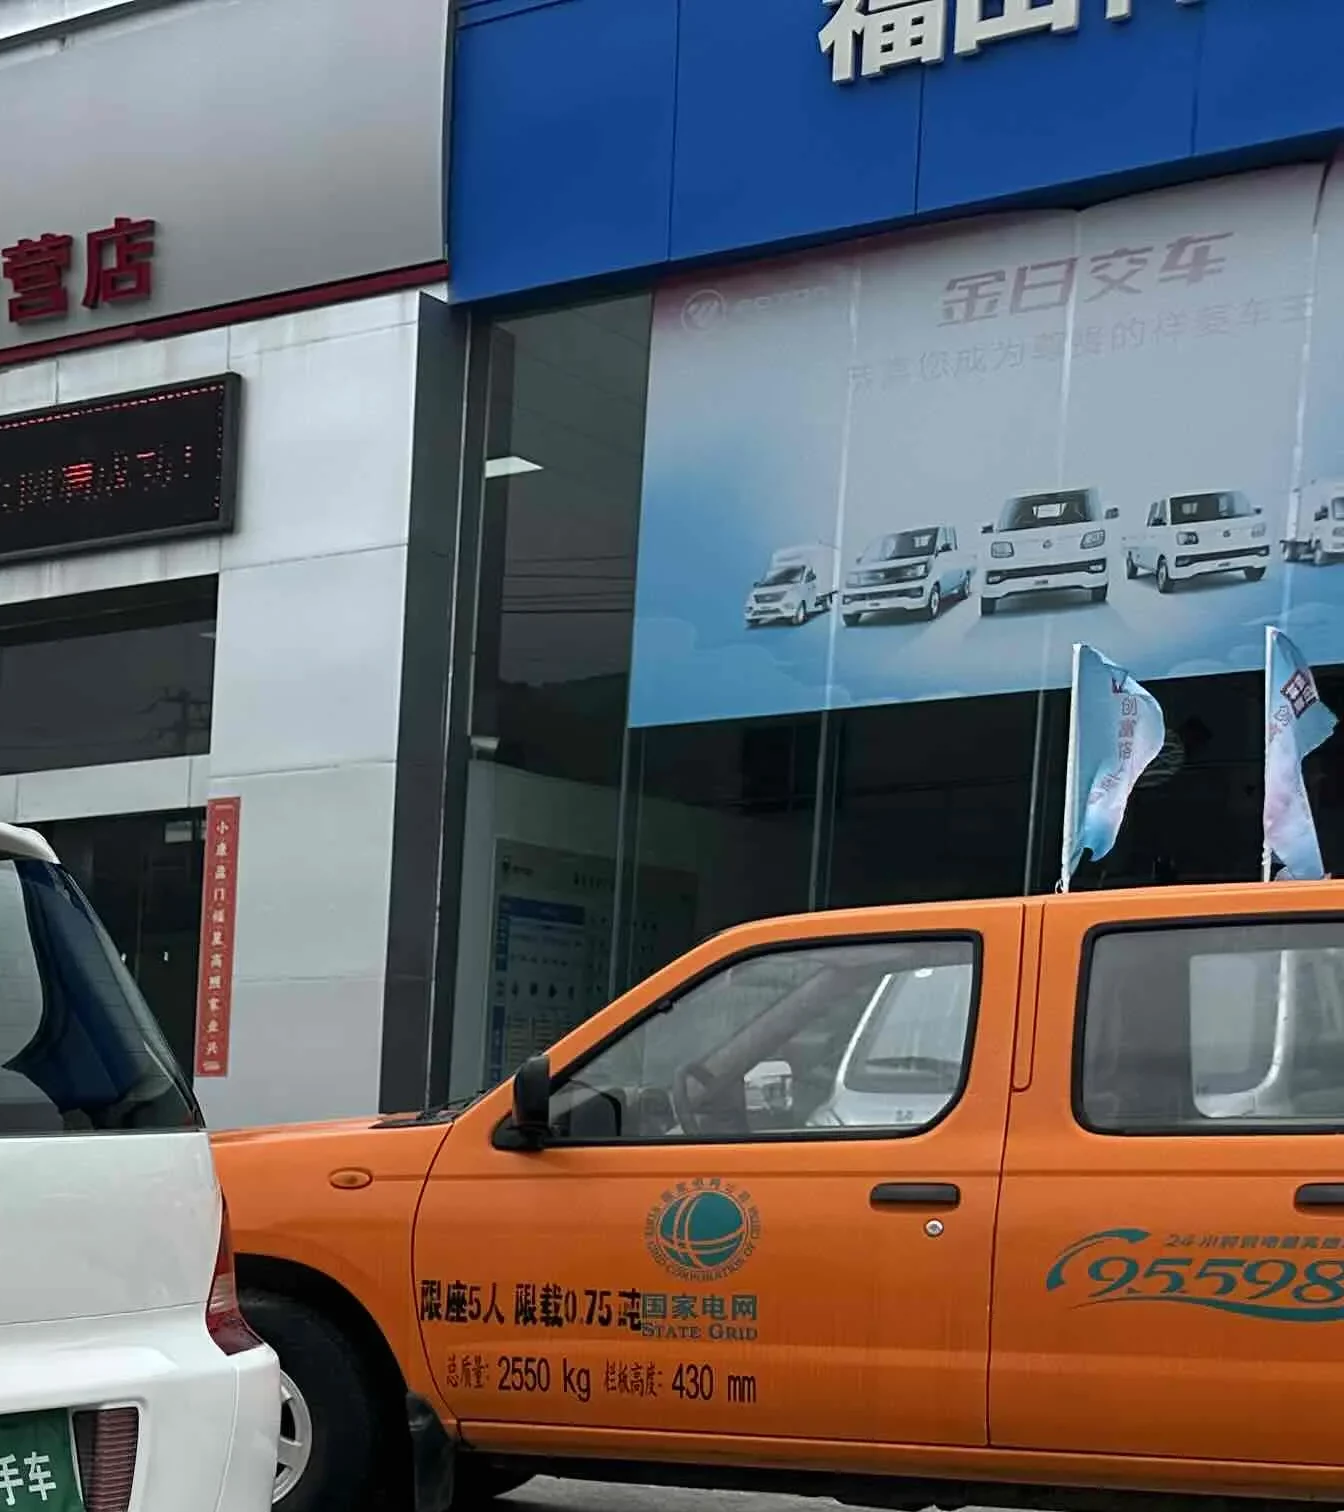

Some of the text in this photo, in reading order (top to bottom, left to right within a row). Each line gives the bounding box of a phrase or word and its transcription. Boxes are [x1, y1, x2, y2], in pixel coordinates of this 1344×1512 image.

[937, 231, 1232, 327] 金日交车
[419, 1279, 506, 1325] 限座5人
[1087, 1255, 1344, 1304] 95598
[642, 1292, 757, 1321] 国家电网
[497, 1355, 551, 1393] 2550
[562, 1357, 592, 1402] kg
[671, 1363, 713, 1400] 430
[726, 1372, 757, 1403] mm
